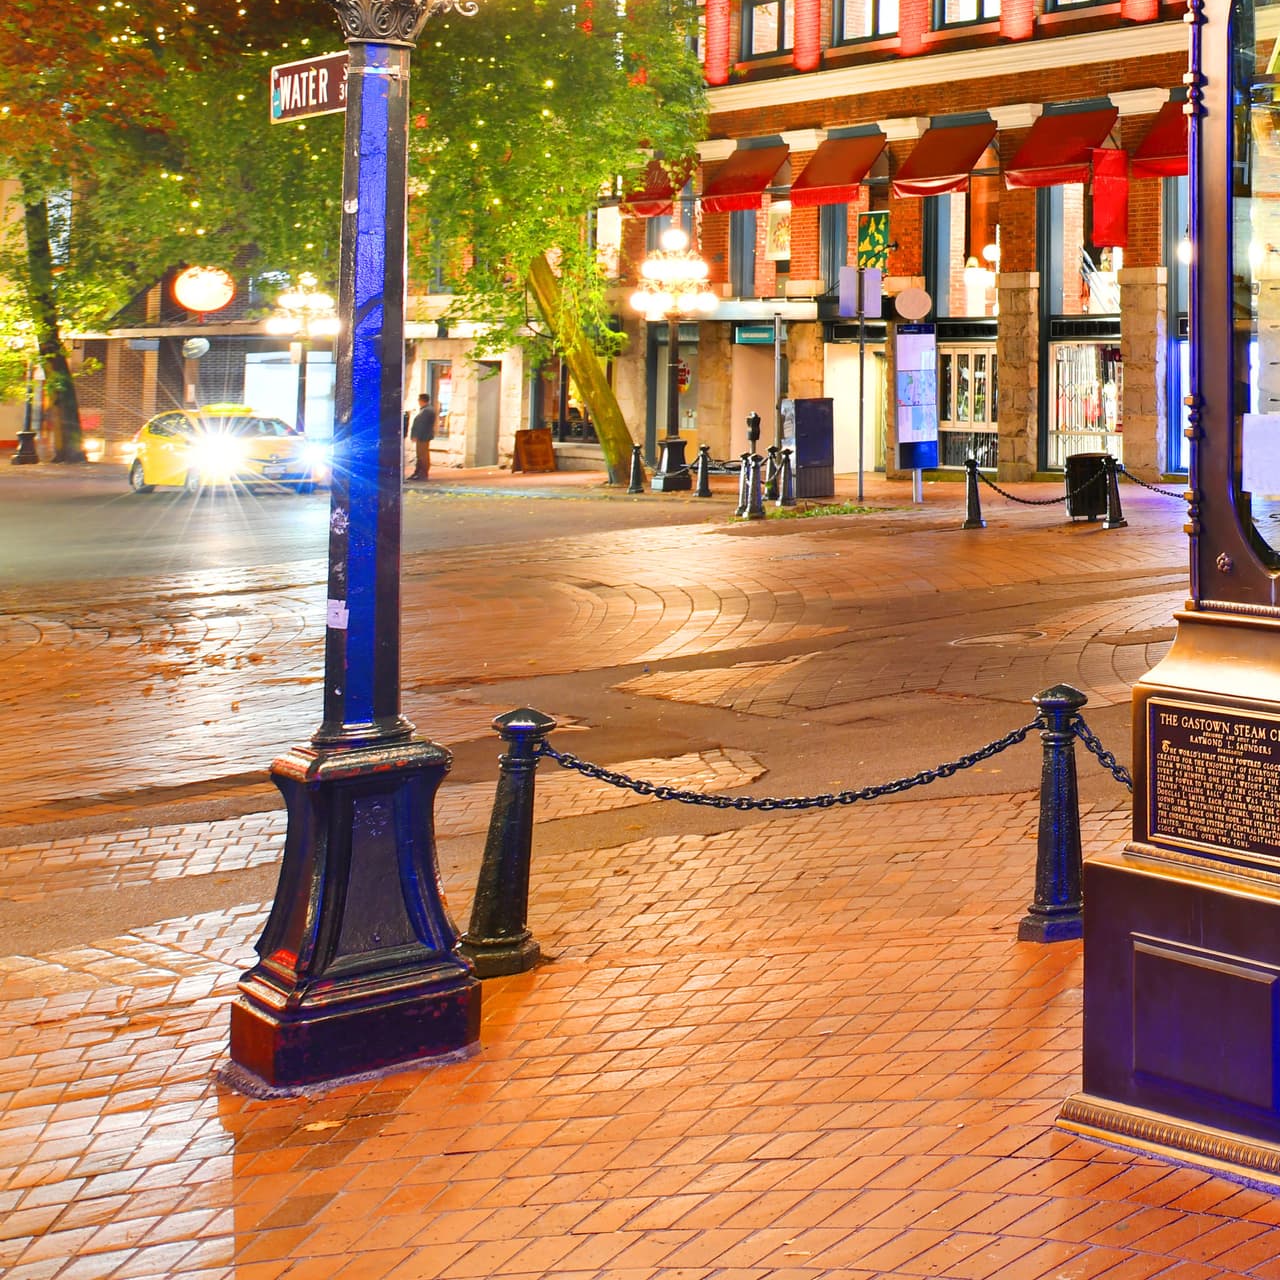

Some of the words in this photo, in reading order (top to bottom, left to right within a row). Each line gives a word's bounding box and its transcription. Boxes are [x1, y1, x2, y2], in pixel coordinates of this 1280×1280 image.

[280, 68, 329, 111] WATER
[1160, 713, 1178, 726] THE
[1182, 716, 1230, 734] GASTOWN
[1234, 723, 1266, 740] STEAM
[1190, 735, 1223, 747] RAYMOND
[1228, 741, 1234, 749] L.
[1236, 742, 1272, 755] SAUNDERS
[1157, 753, 1180, 762] CREATED
[1182, 757, 1192, 765] FOR
[1205, 761, 1237, 772] ENJOYMENT
[1157, 760, 1173, 768] STEAM
[1195, 766, 1205, 774] THE
[1208, 768, 1232, 778] WEIGHTS
[1233, 772, 1245, 780] AND
[1268, 778, 1279, 786] THE
[1202, 753, 1216, 761] FIRST
[1217, 755, 1233, 764] STEAM
[1236, 758, 1261, 768] POWERED
[1263, 762, 1280, 772] CLOCK
[1157, 767, 1174, 775] EVERY
[1240, 781, 1262, 790] WEIGHT
[1264, 785, 1277, 793] WILL
[1157, 774, 1173, 782] STEAM
[1175, 777, 1193, 786] POWER
[1235, 787, 1245, 795] THE
[1157, 788, 1180, 798] DOUGLAS
[1264, 807, 1274, 815] THE
[1245, 796, 1258, 805] WAS
[1158, 810, 1167, 818] THE
[1233, 824, 1257, 835] CENTRAL
[1258, 828, 1271, 837] HEAT
[1205, 811, 1213, 819] ON
[1215, 813, 1224, 821] THE
[1242, 818, 1252, 826] THE
[1253, 820, 1270, 829] STEAM
[1253, 812, 1263, 820] THE
[1157, 824, 1175, 834] CLOCK
[1178, 828, 1198, 838] WEIGHS
[1201, 832, 1215, 841] OVER
[1218, 836, 1231, 844] TWO
[1184, 822, 1193, 830] THE
[1249, 834, 1264, 843] COST
